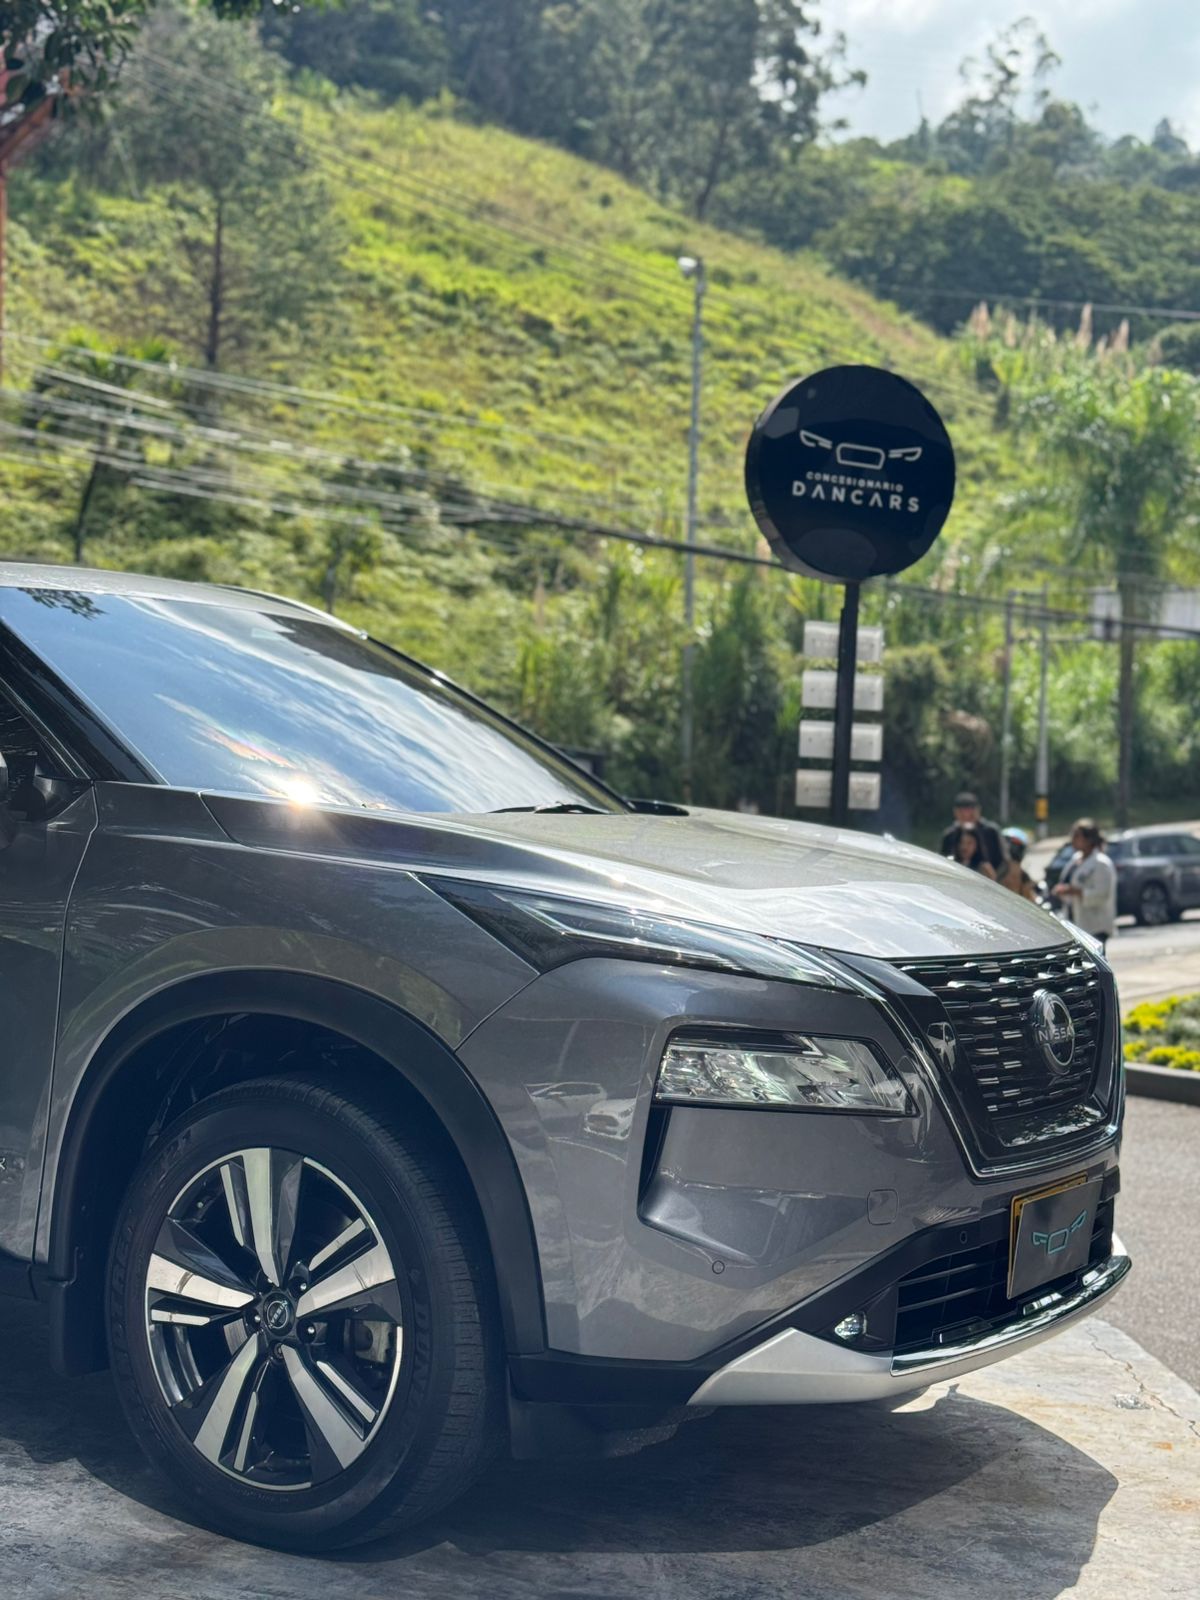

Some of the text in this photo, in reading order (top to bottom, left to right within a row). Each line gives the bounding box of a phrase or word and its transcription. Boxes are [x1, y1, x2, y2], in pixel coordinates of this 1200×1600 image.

[805, 471, 904, 492] CONCESIONARIO
[791, 479, 920, 512] DANCARS
[1038, 1025, 1075, 1041] NISSA
